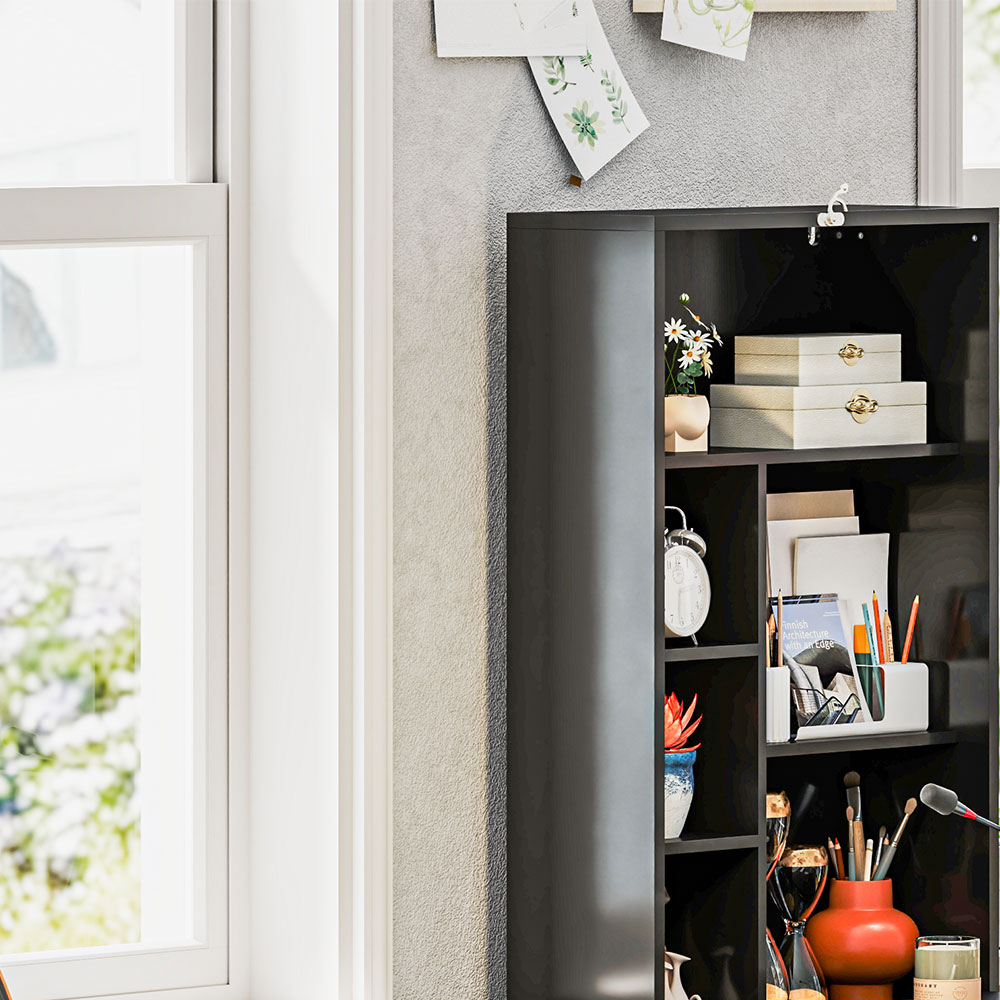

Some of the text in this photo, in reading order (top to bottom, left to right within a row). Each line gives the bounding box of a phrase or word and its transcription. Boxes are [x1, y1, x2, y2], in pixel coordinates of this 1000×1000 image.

[783, 630, 829, 640] Architecture
[785, 641, 801, 650] with
[816, 640, 834, 650] Edge
